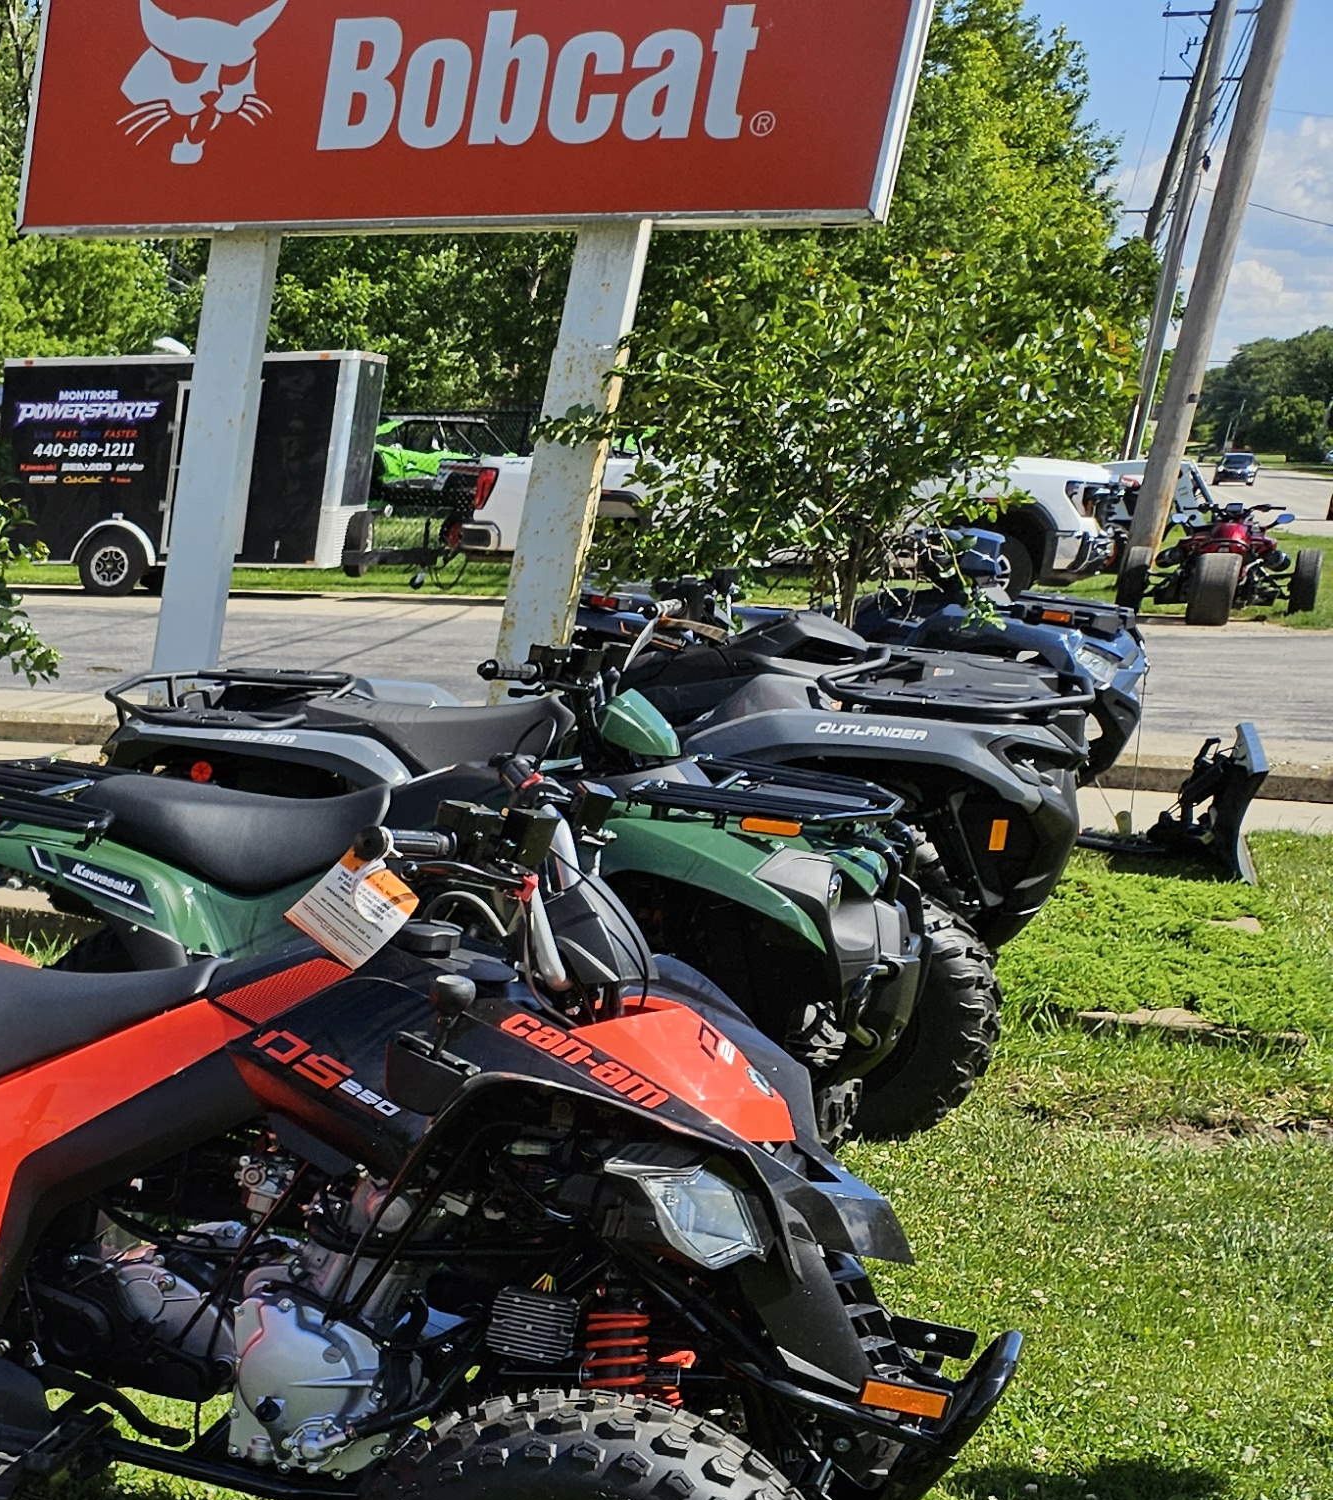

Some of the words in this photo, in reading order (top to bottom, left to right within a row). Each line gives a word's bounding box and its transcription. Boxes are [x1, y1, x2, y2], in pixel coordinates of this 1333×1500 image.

[316, 3, 760, 151] Bobcat
[58, 390, 119, 401] MONTROSE
[16, 401, 162, 425] POWERSPORTS
[33, 442, 135, 458] 440-969-1211
[20, 463, 57, 472] Kawasaki
[221, 729, 299, 745] can-am
[814, 721, 929, 742] OUTLANDER
[70, 862, 137, 897] Kawasaki
[499, 1012, 673, 1111] can-am
[252, 1028, 355, 1091] DS
[338, 1077, 402, 1118] 250
